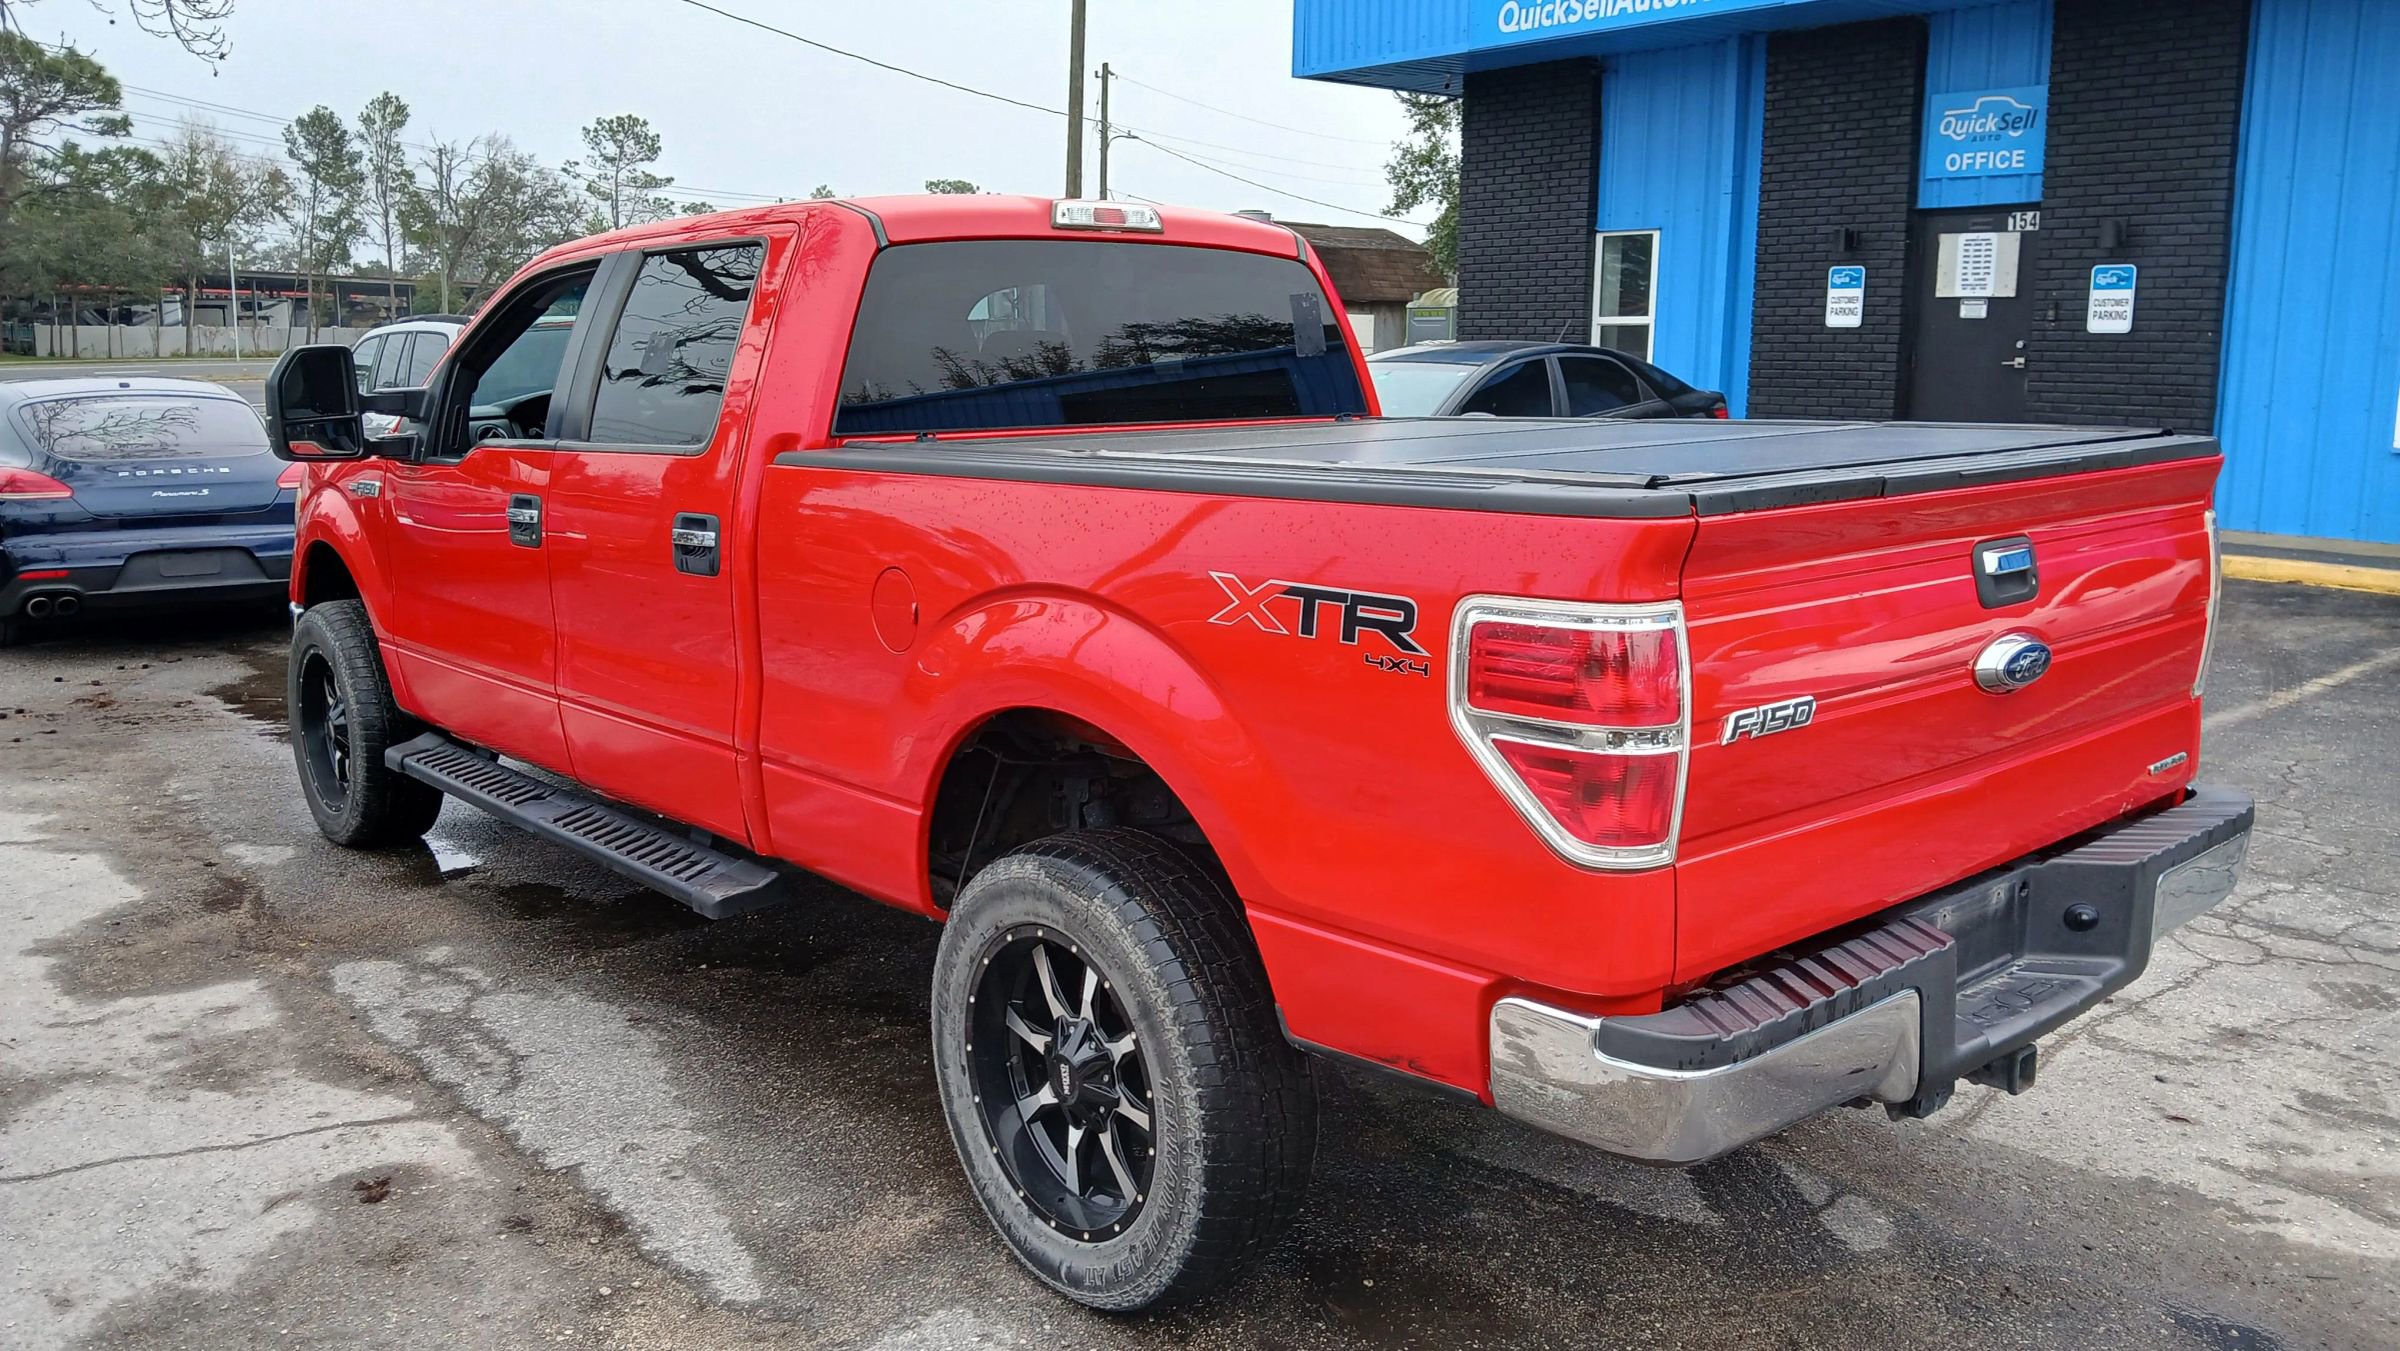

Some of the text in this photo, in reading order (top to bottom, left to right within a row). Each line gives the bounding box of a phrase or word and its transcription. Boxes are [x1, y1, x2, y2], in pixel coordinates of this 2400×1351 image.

[1945, 149, 2025, 171] OFFICE
[2010, 212, 2037, 230] 154
[2092, 310, 2128, 321] PARKING
[118, 467, 230, 477] PORSCHE
[1207, 570, 1432, 658] XTR
[2010, 649, 2050, 679] Ford
